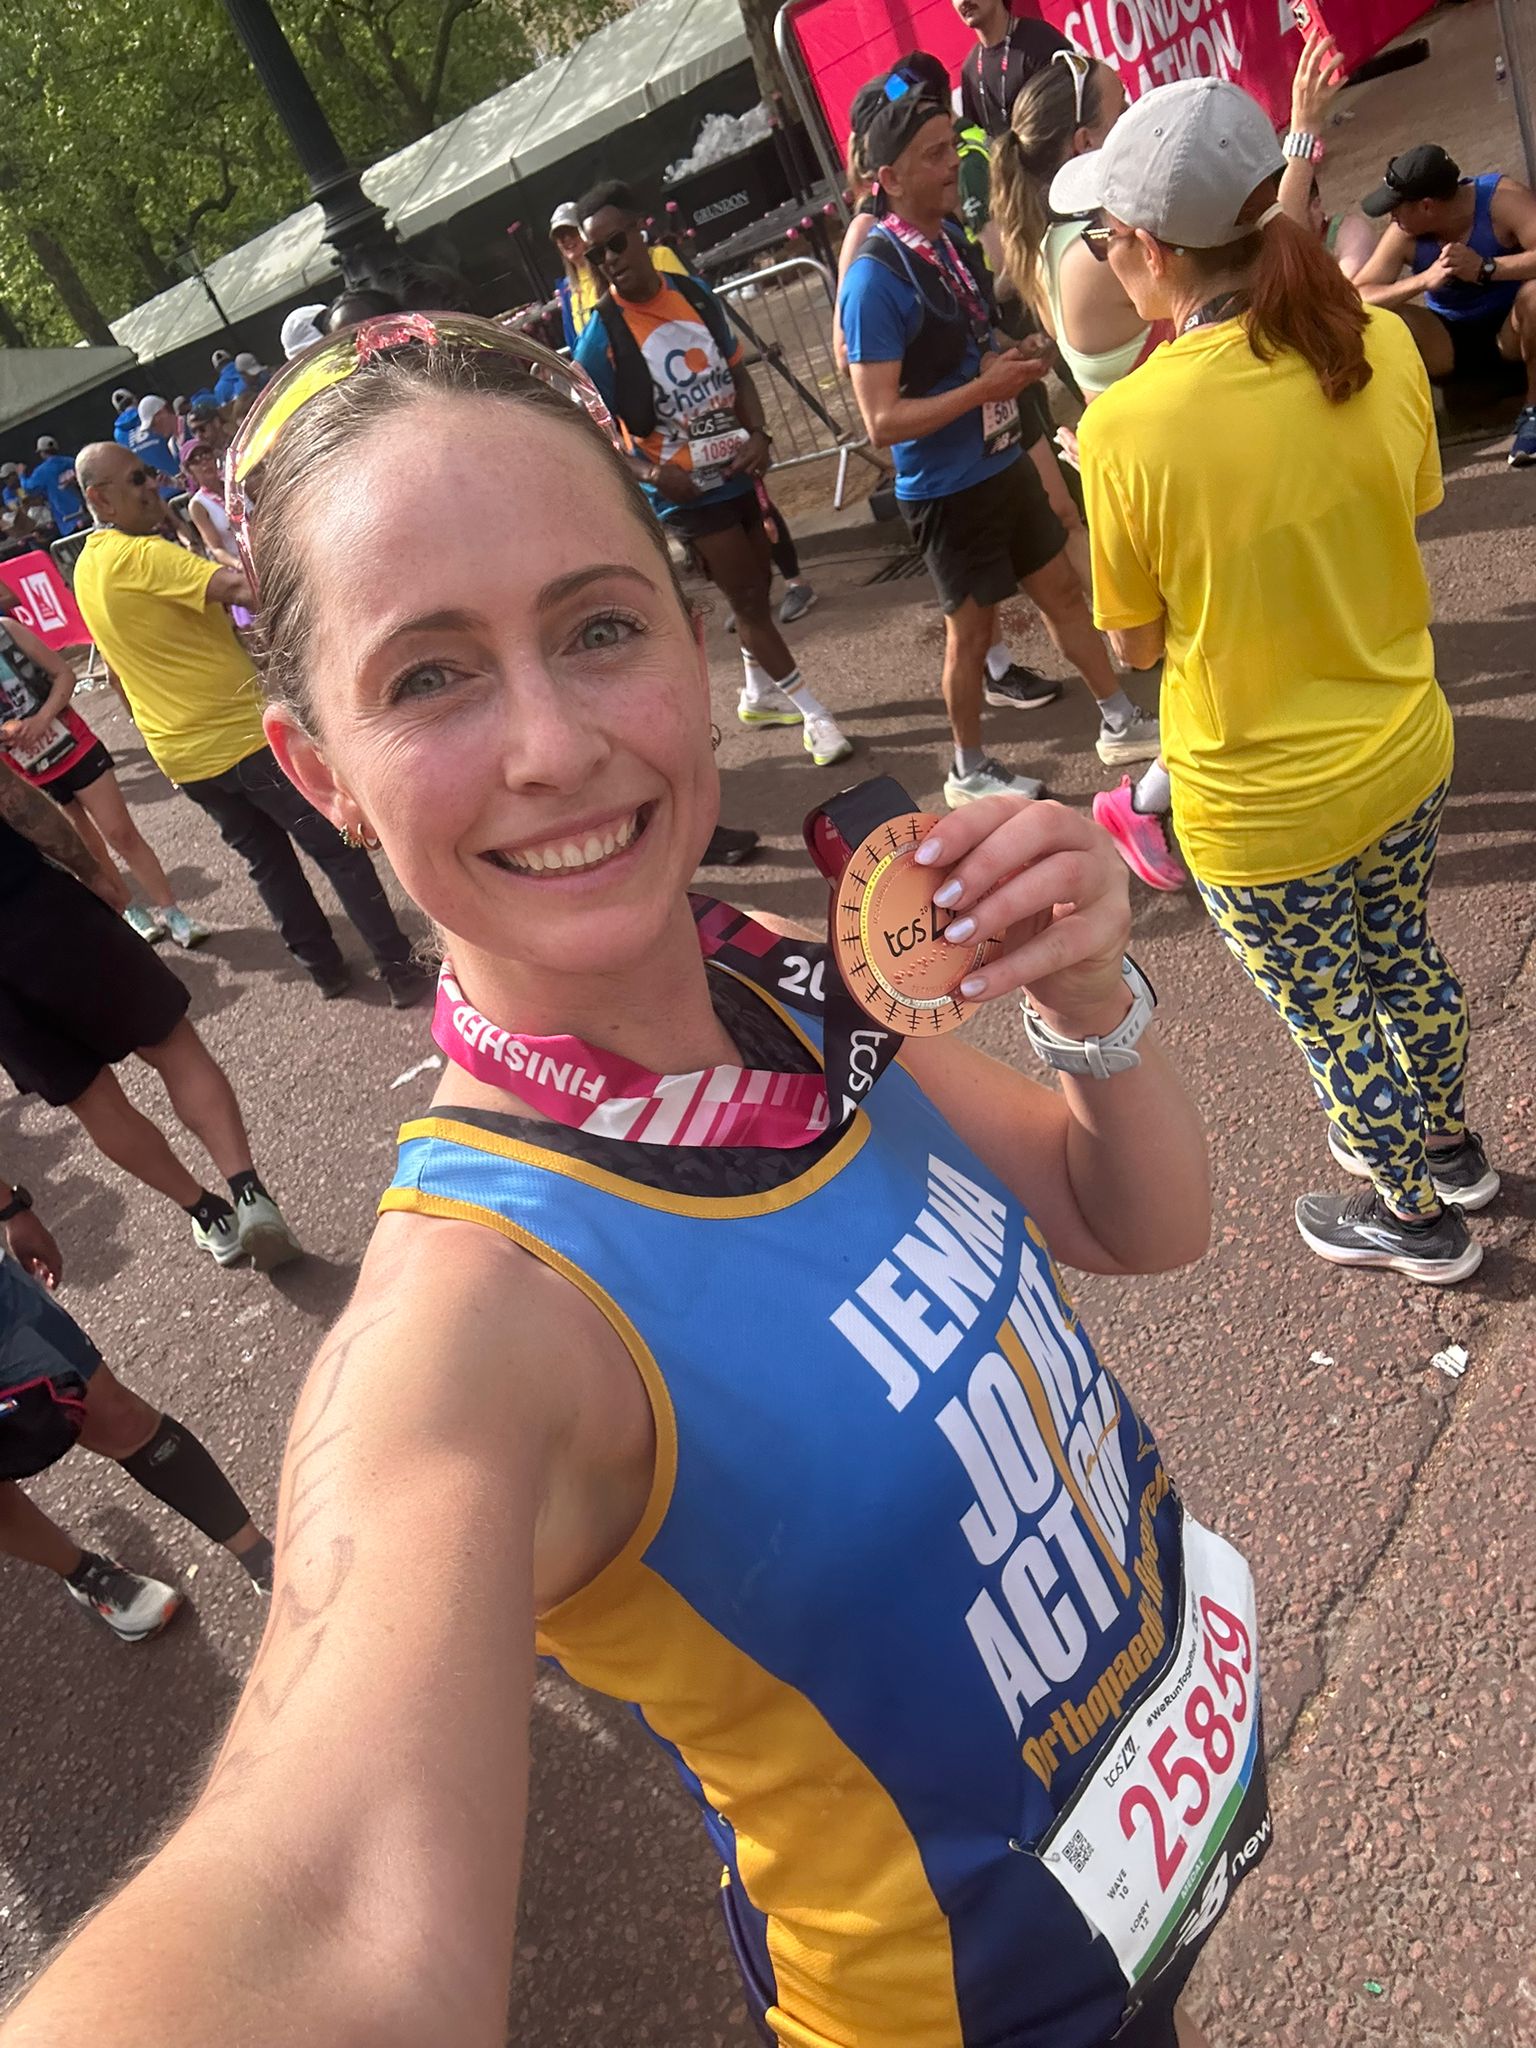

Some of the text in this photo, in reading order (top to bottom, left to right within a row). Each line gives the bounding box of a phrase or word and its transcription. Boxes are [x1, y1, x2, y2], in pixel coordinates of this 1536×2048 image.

[1083, 0, 1223, 72] LOND
[884, 918, 927, 957] tcs
[829, 1154, 1008, 1412] JENNA
[1146, 1639, 1198, 1728] #WeRunTogether
[1118, 1594, 1252, 1893] 25859
[1107, 1868, 1128, 1900] WAVE
[1179, 1858, 1205, 1900] MEDAL
[1130, 1899, 1150, 1934] LORRY
